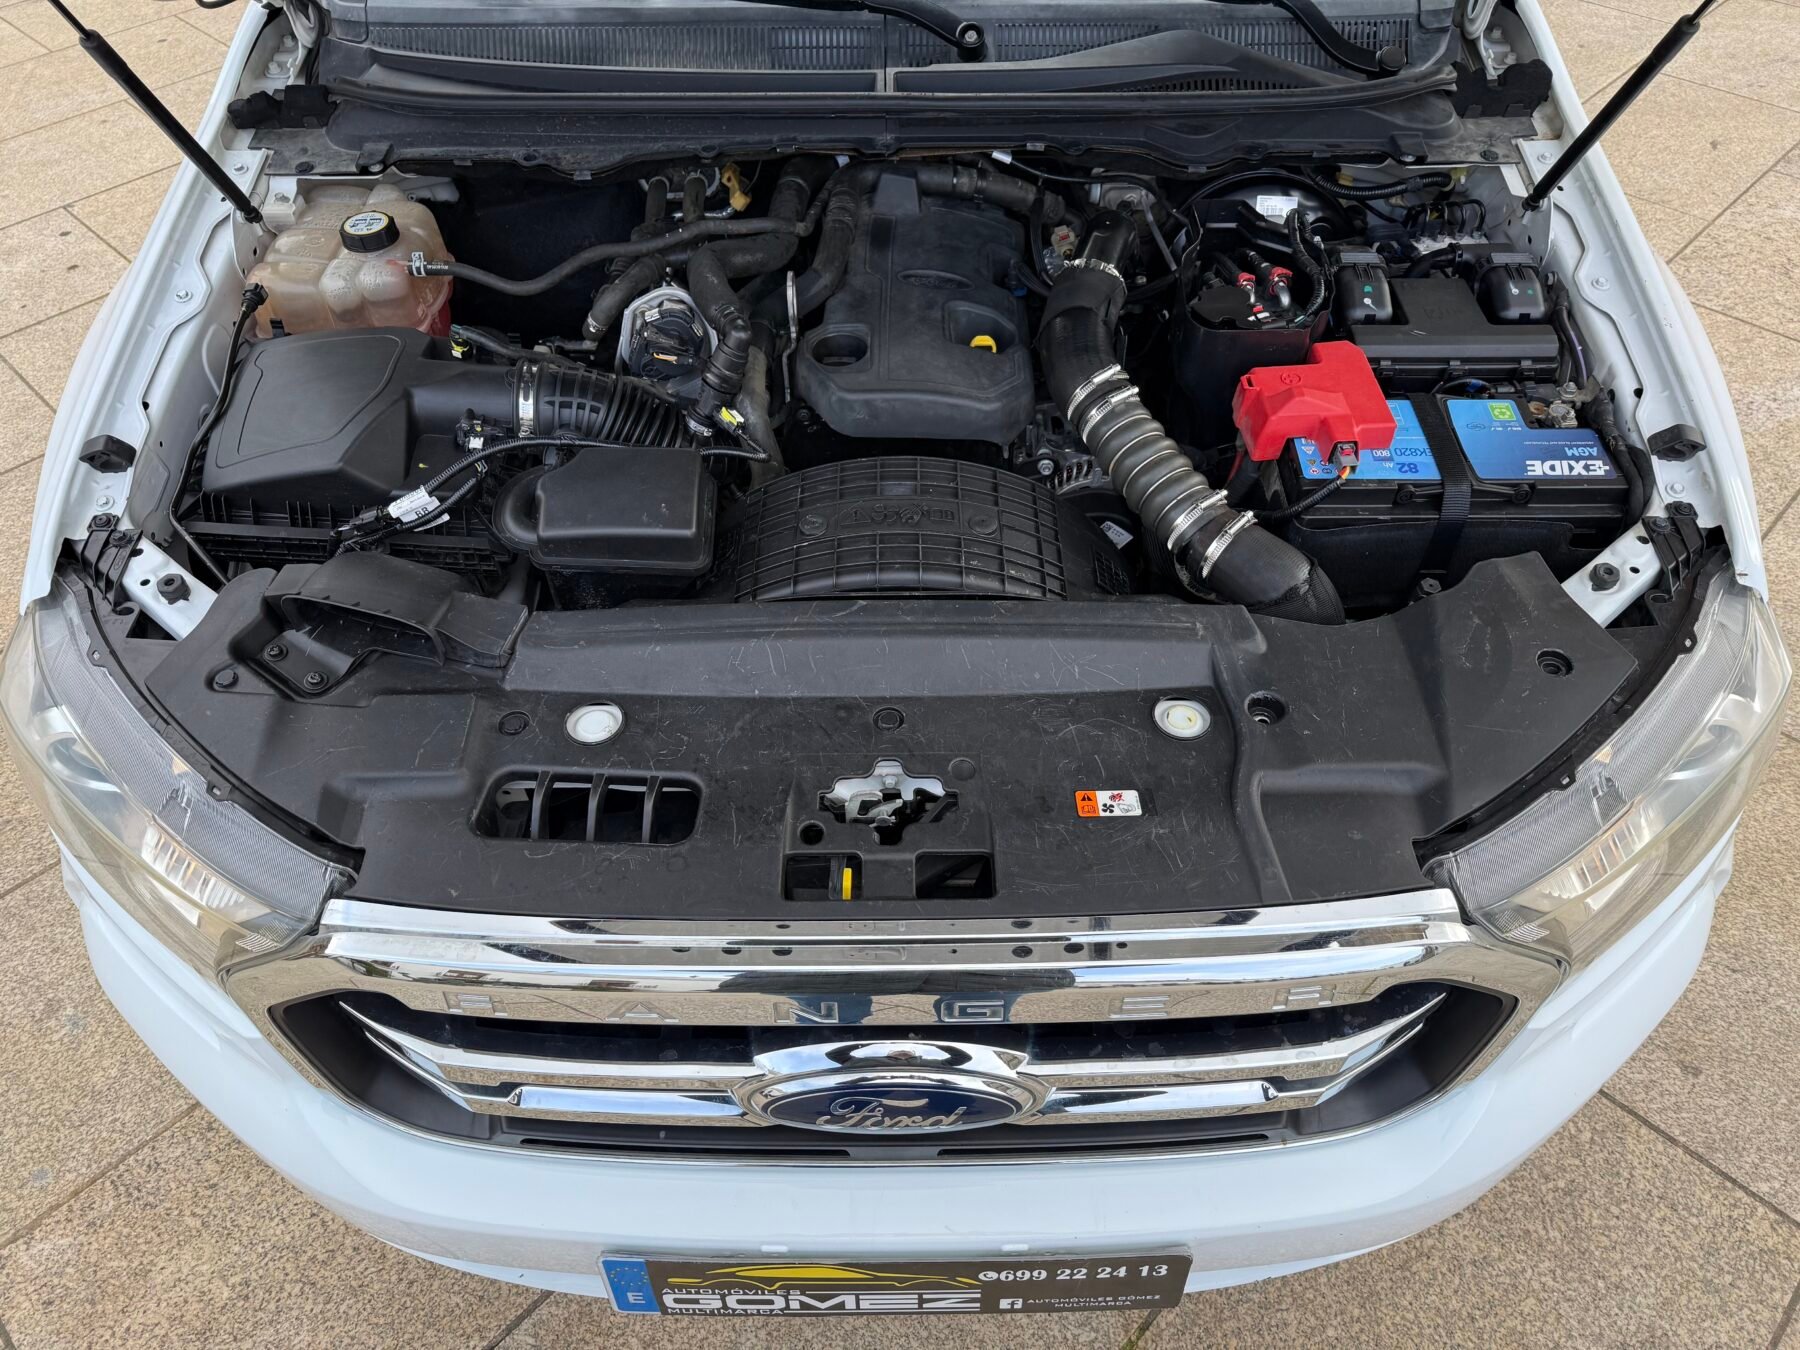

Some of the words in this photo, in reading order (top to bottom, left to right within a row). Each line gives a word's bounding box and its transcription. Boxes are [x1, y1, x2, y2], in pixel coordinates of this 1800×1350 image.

[1373, 449, 1391, 457] 800
[1564, 446, 1598, 457] AGM
[1396, 462, 1419, 474] 82
[1526, 460, 1609, 476] EXIDE
[443, 985, 1337, 1023] RANGER
[815, 1096, 967, 1130] Ford
[1000, 1269, 1048, 1282] 699
[1056, 1267, 1089, 1280] 22
[1096, 1266, 1128, 1279] 24
[1139, 1264, 1169, 1277] 13
[661, 1286, 801, 1296] AUTOMÓVILES
[627, 1292, 646, 1304] E
[662, 1293, 981, 1310] GOMEZ
[667, 1307, 784, 1315] MULTIMARCA
